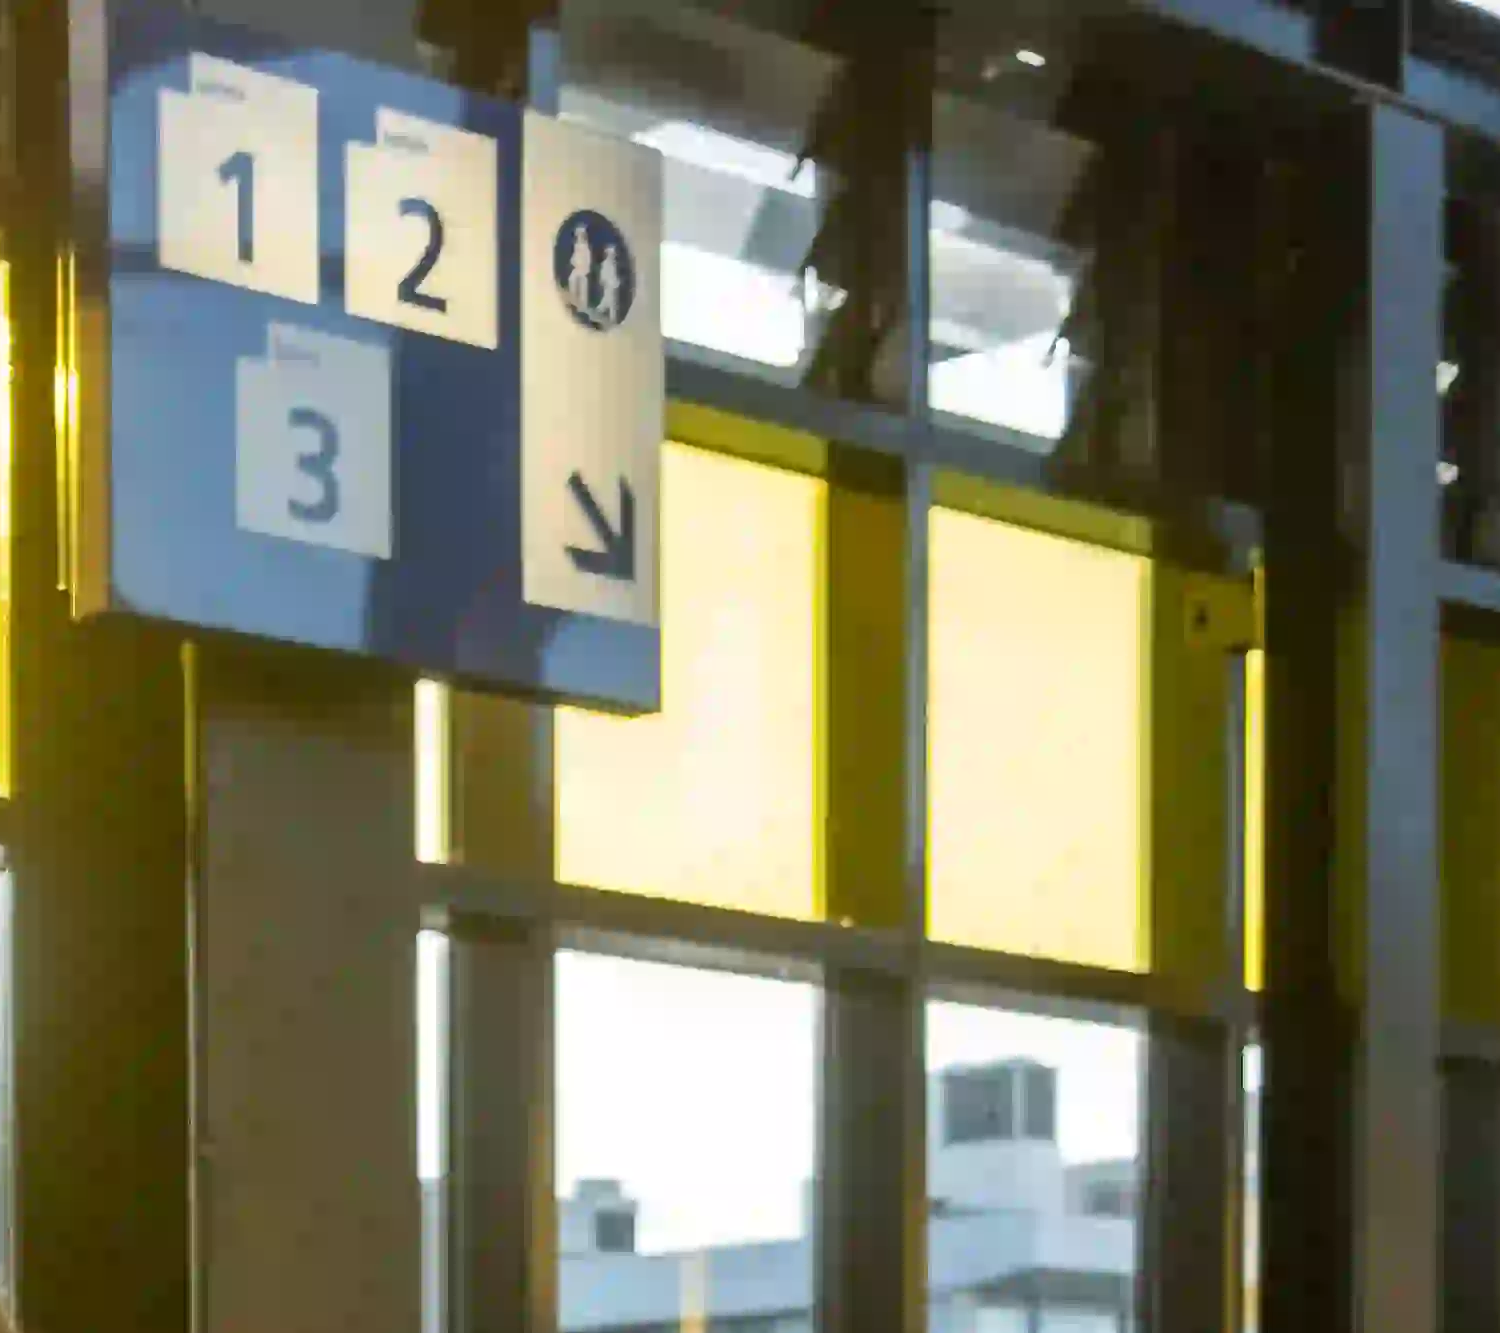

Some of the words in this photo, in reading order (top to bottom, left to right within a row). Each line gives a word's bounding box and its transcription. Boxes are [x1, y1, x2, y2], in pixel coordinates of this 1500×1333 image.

[218, 151, 254, 263] 1
[398, 198, 447, 313] 2
[287, 407, 339, 522] 3
